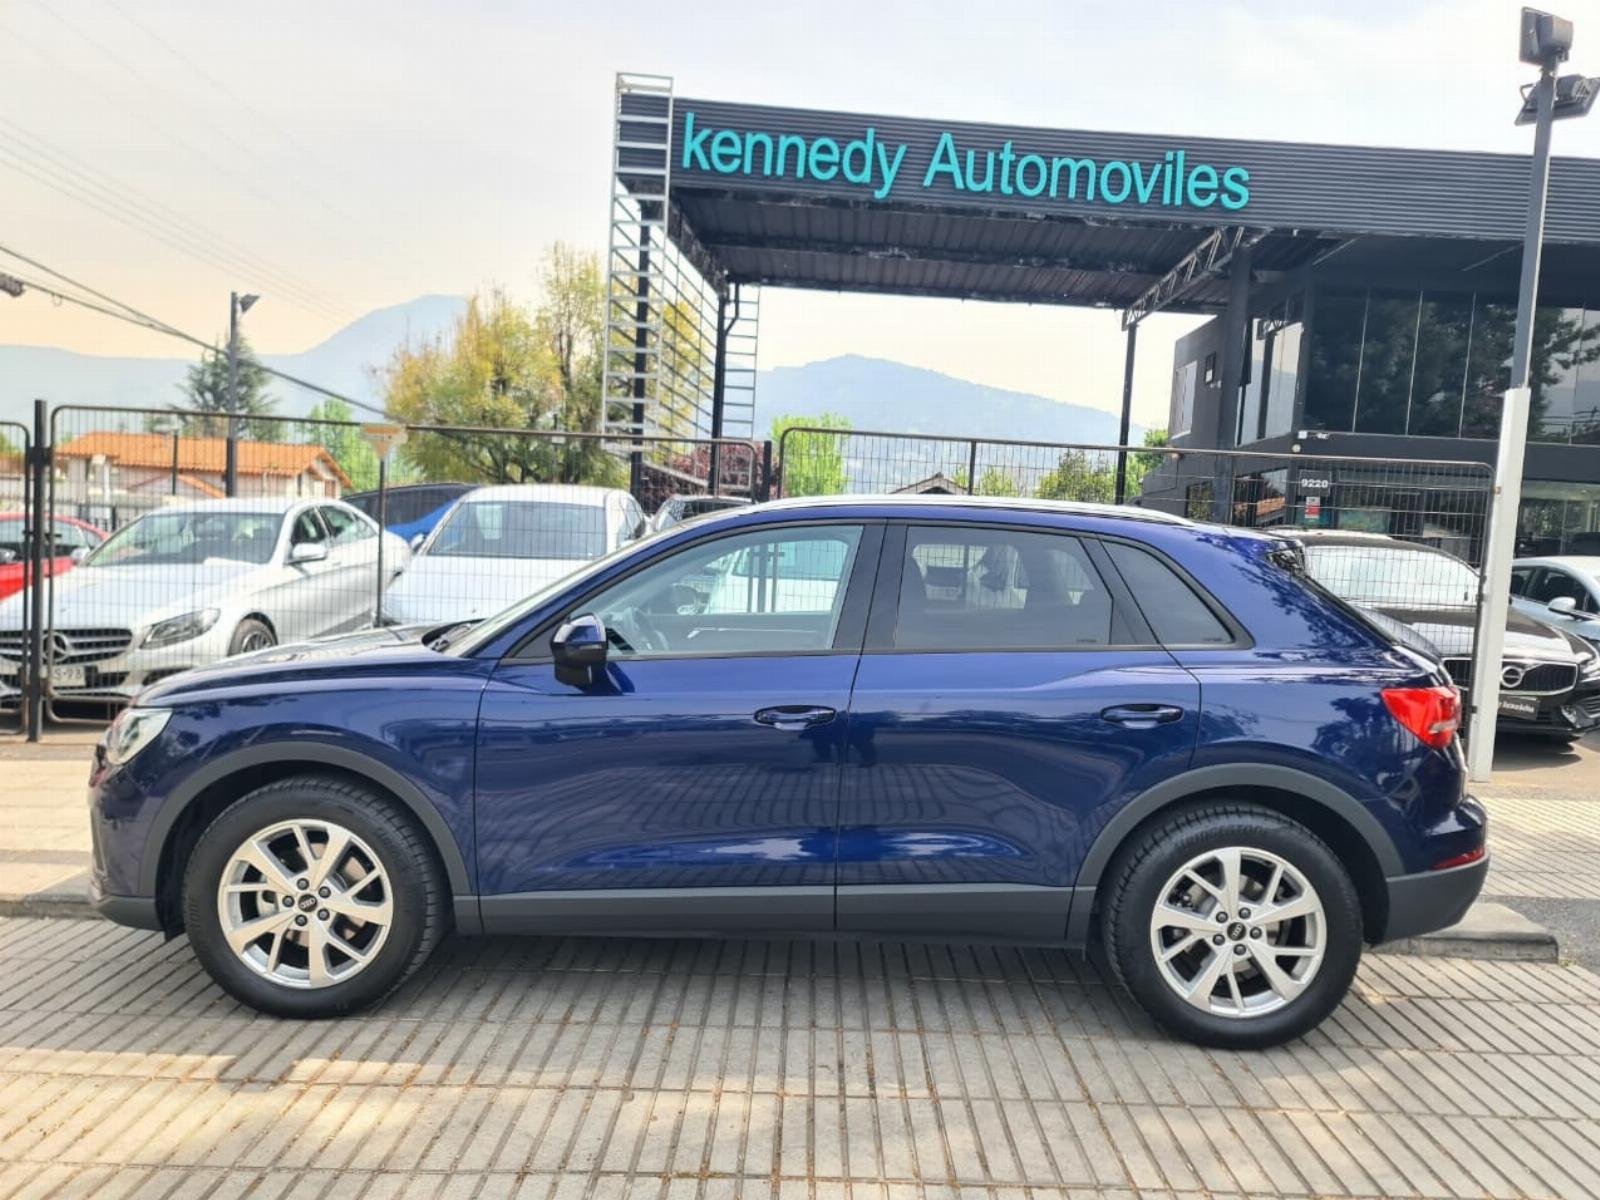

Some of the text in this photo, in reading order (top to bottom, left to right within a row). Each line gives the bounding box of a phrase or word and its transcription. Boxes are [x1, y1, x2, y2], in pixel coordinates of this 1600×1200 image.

[682, 112, 1250, 210] kennedy Automoviles
[1301, 479, 1329, 489] 9220
